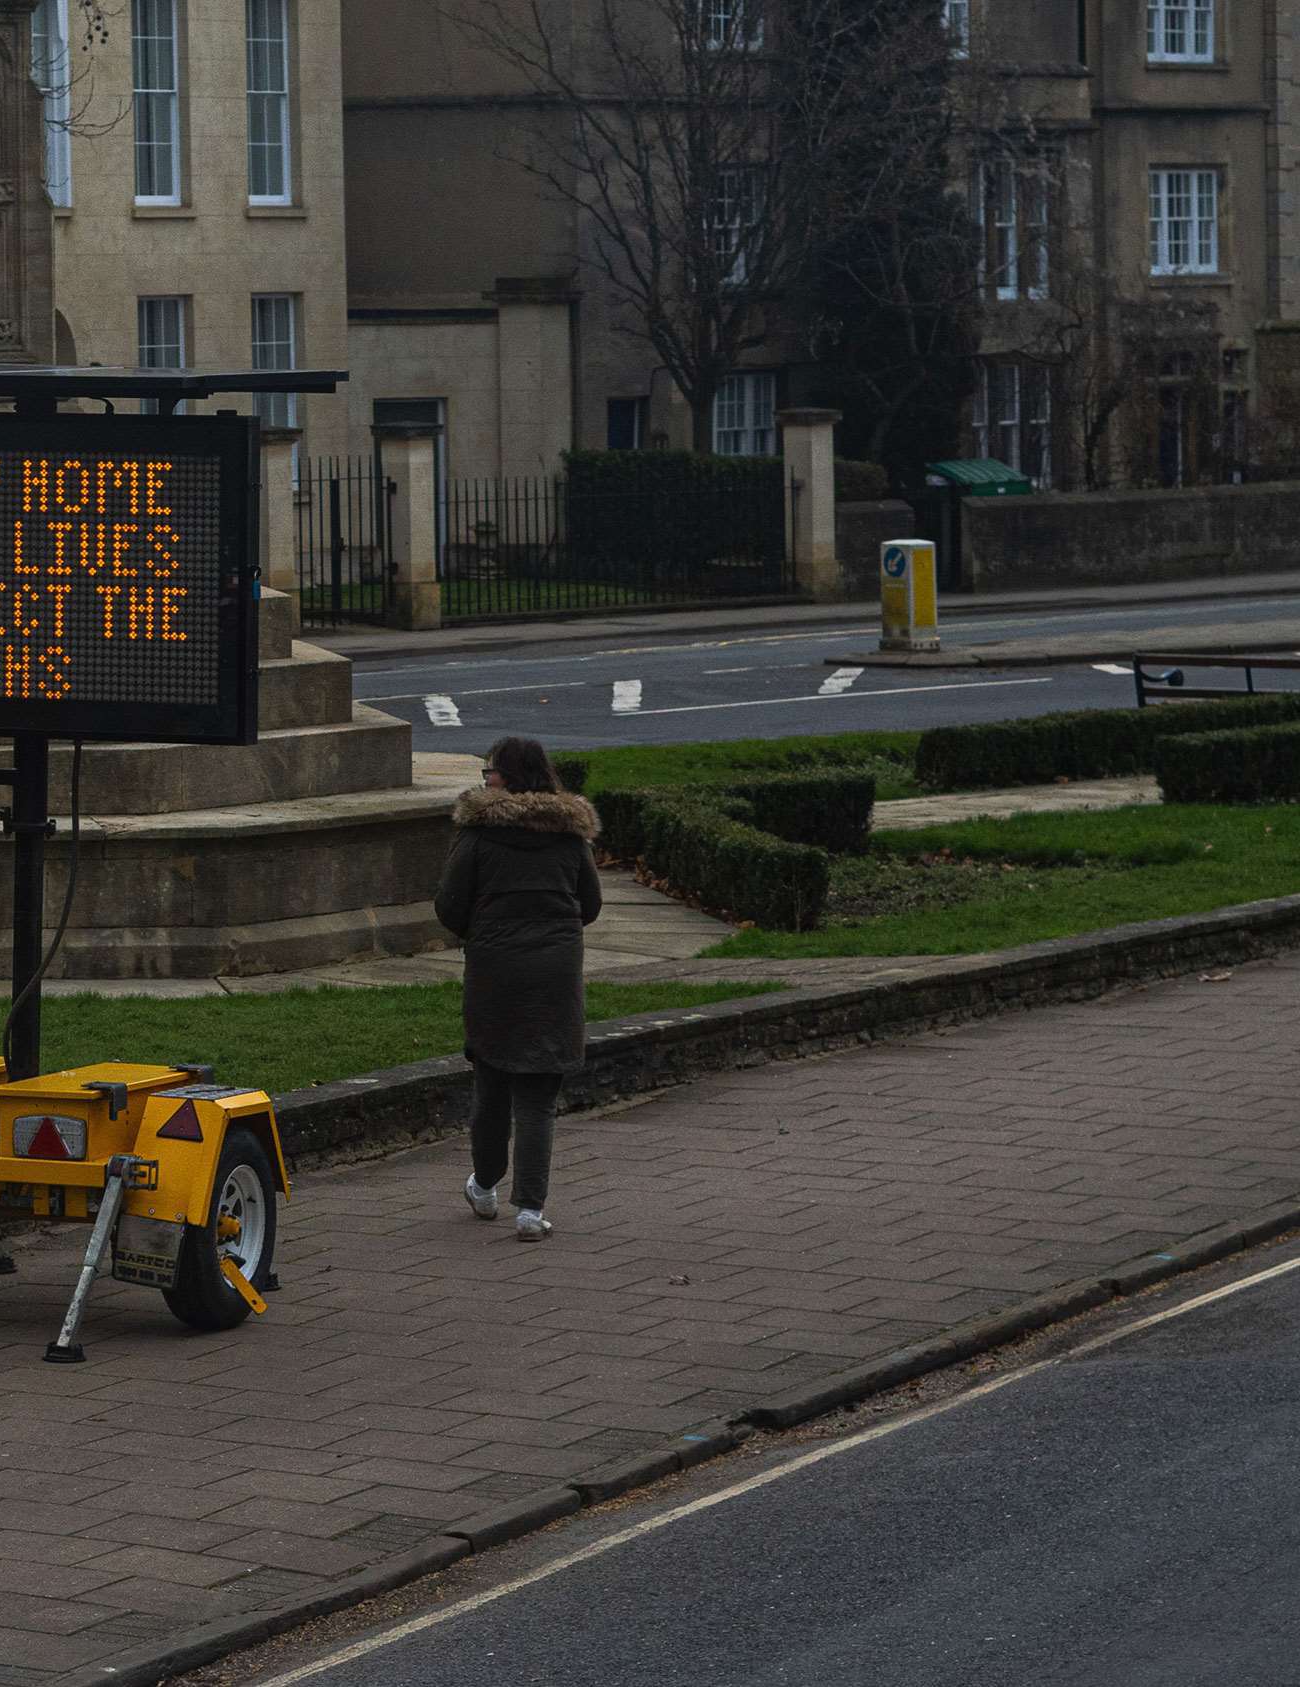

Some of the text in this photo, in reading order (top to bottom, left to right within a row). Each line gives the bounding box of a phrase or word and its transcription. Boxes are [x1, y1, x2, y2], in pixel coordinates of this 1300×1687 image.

[22, 459, 173, 516] HOME
[14, 520, 180, 577] LIVES
[96, 585, 188, 641] THE
